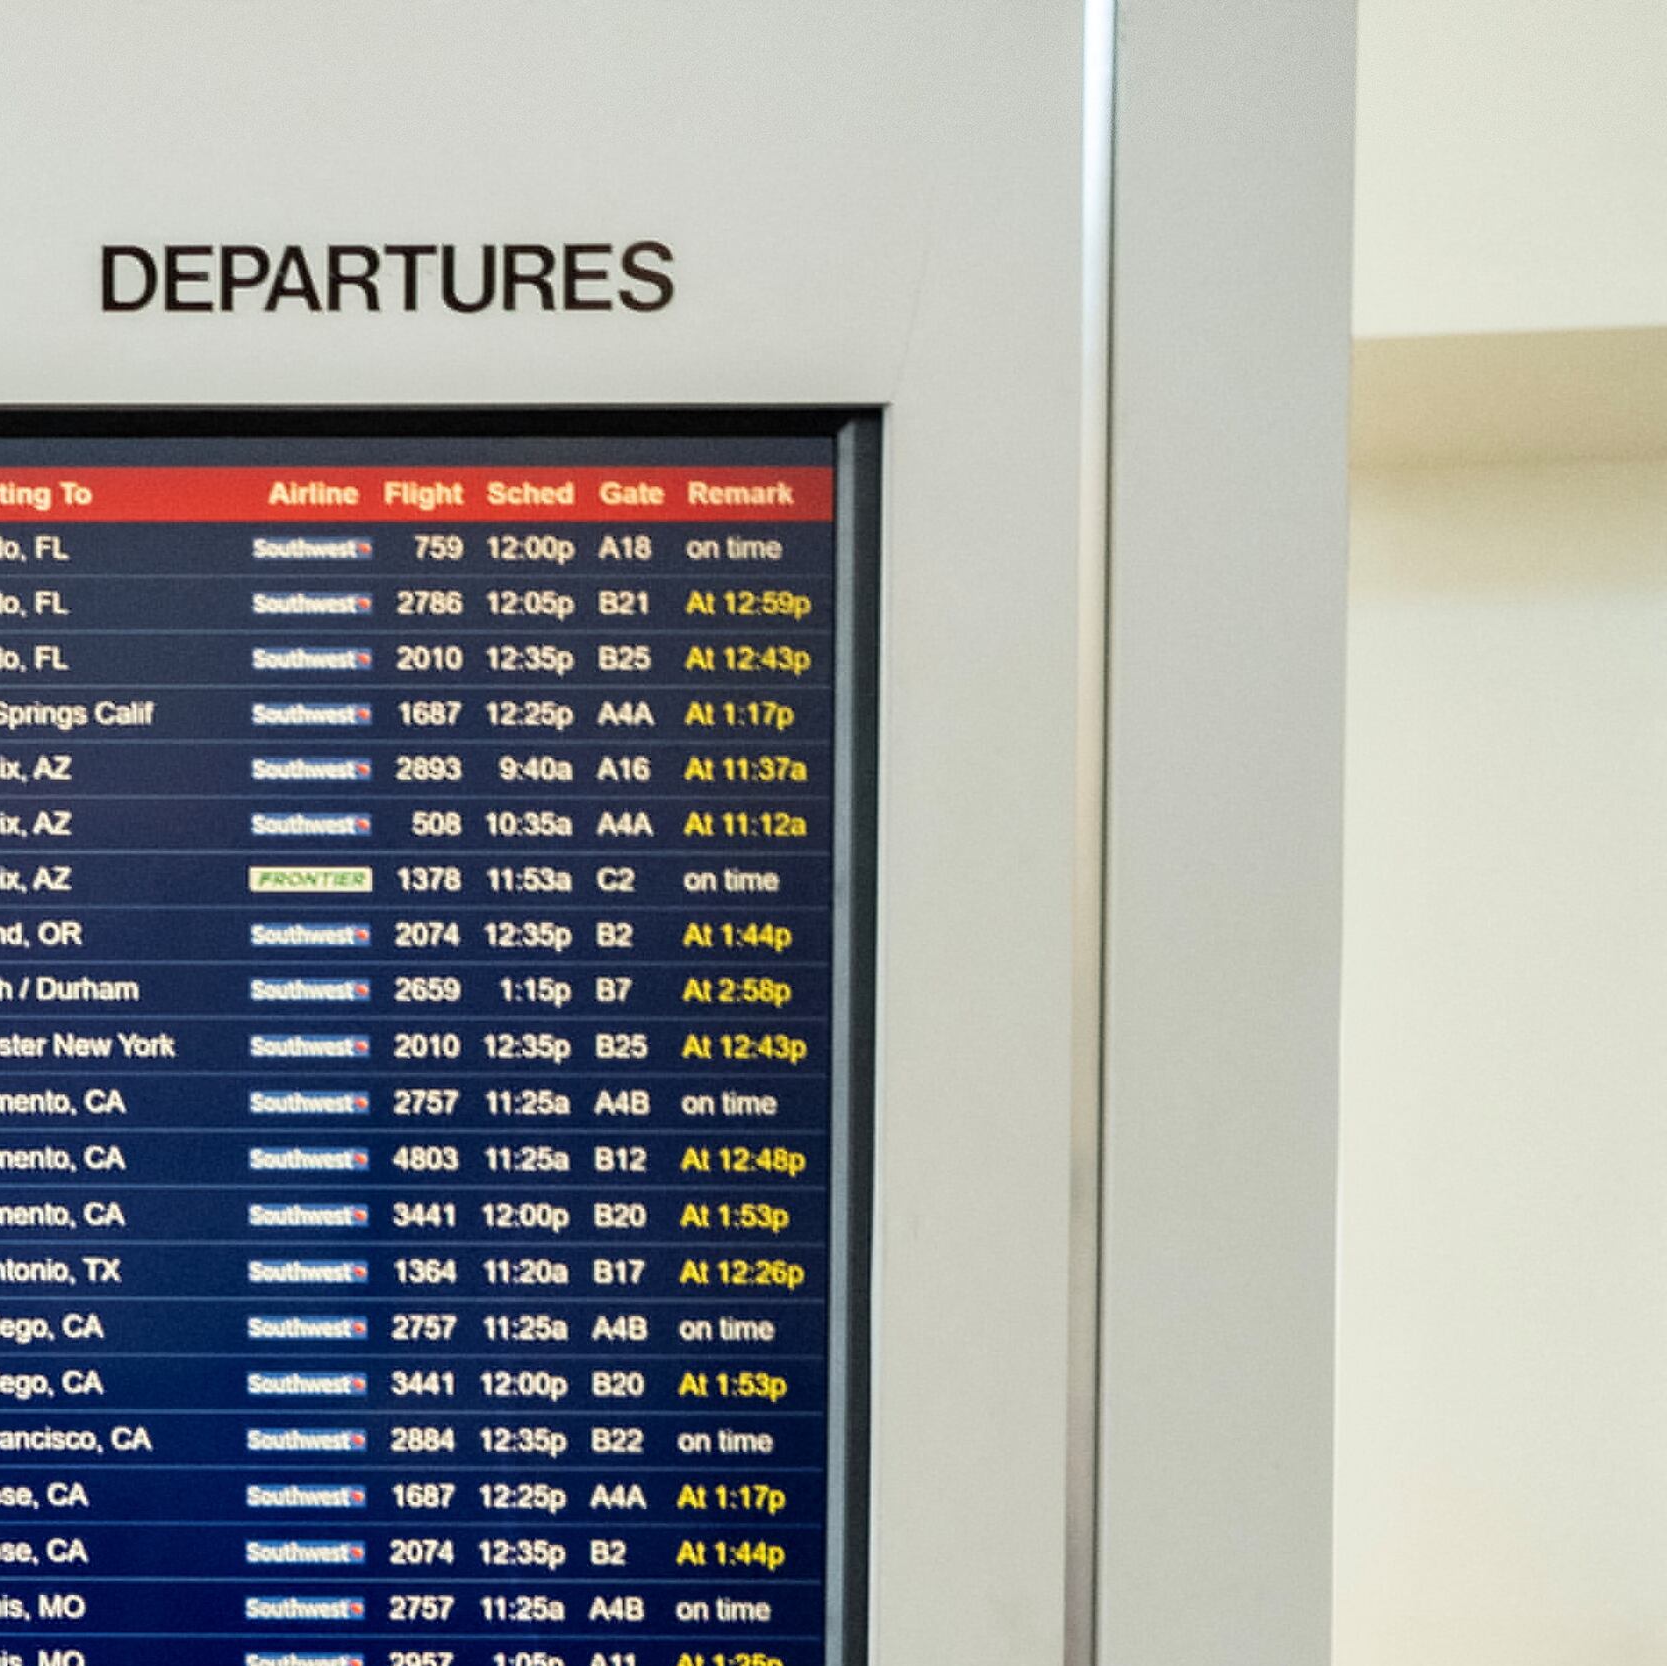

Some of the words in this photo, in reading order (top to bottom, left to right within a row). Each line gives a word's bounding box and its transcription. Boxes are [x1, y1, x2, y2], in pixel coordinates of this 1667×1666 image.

[101, 241, 674, 314] DEPARTURES
[59, 481, 93, 506] To
[268, 481, 359, 505] Airline
[384, 481, 464, 511] Flight
[487, 481, 575, 506] Sched
[599, 481, 665, 505] Gate
[688, 481, 794, 505] Remark
[94, 700, 155, 726] Calif
[252, 703, 356, 724] Southwest
[398, 700, 462, 726] 1687
[486, 700, 574, 731] 12:25p
[597, 700, 655, 726] A4A
[684, 701, 715, 725] At
[724, 700, 795, 731] 1:17p
